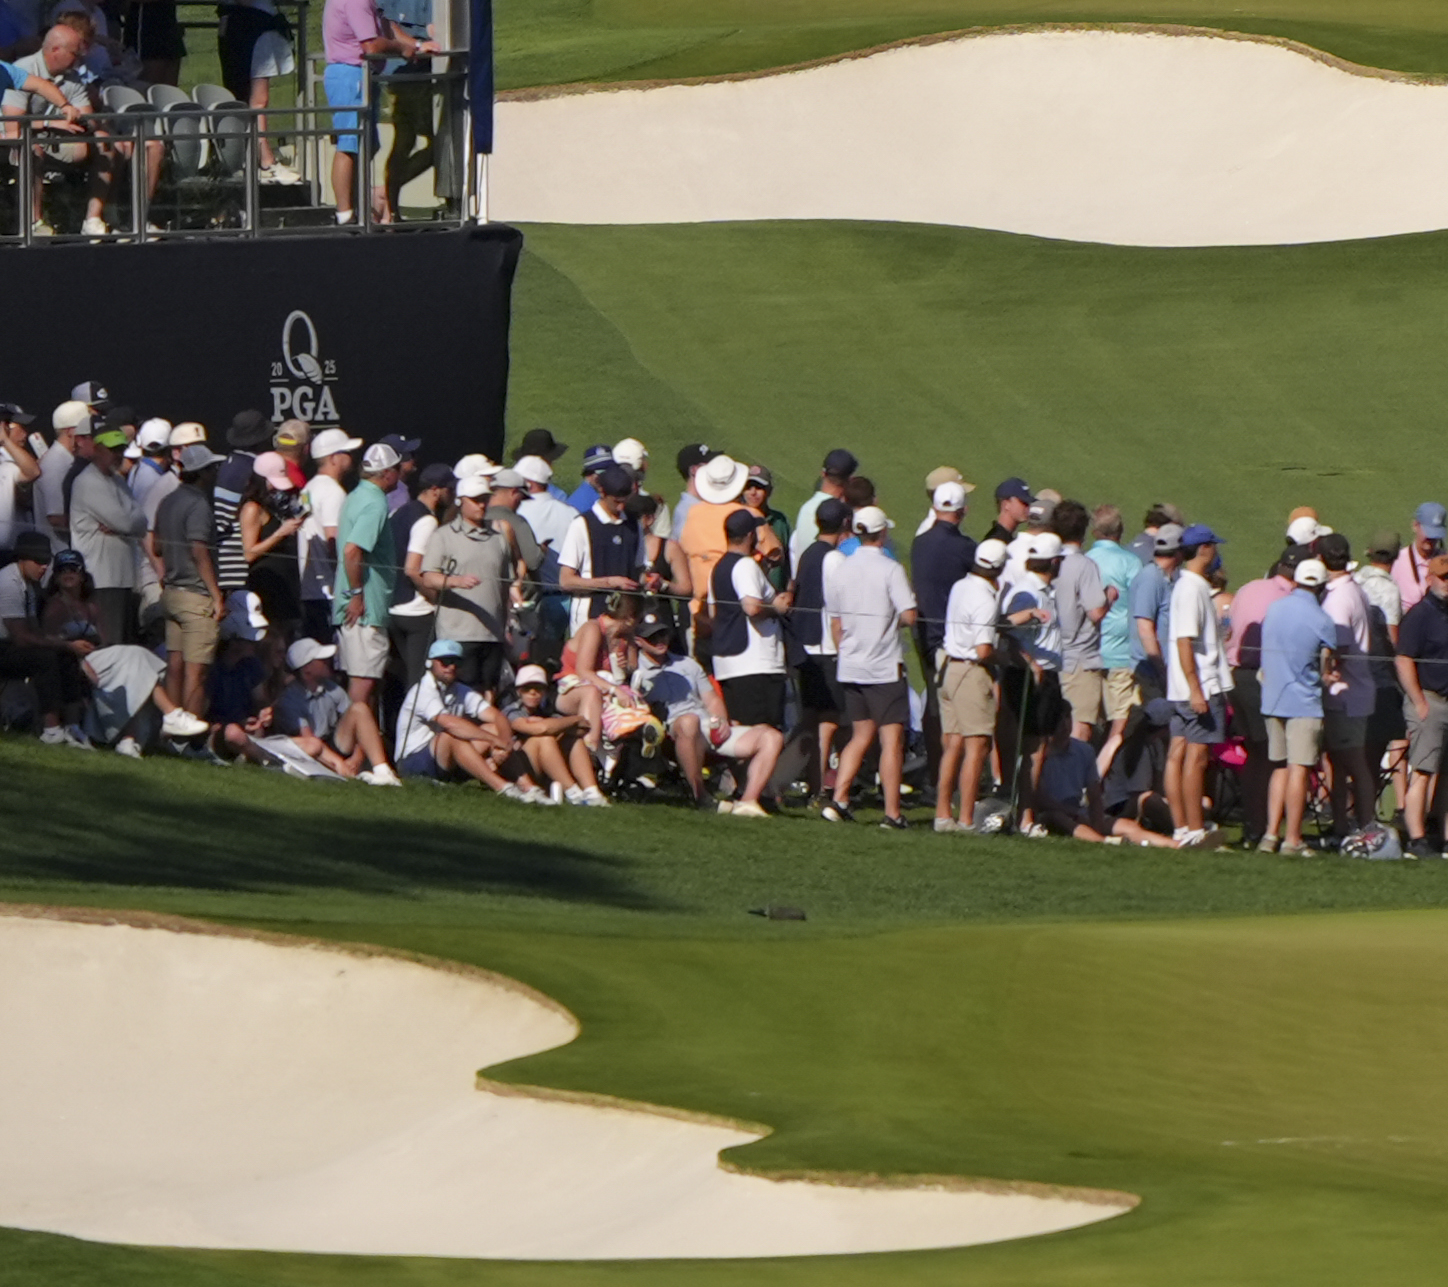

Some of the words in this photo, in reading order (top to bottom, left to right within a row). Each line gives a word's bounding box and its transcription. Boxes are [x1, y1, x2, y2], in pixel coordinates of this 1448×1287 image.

[271, 362, 283, 376] 20
[324, 360, 337, 374] 25
[270, 386, 340, 422] PGA
